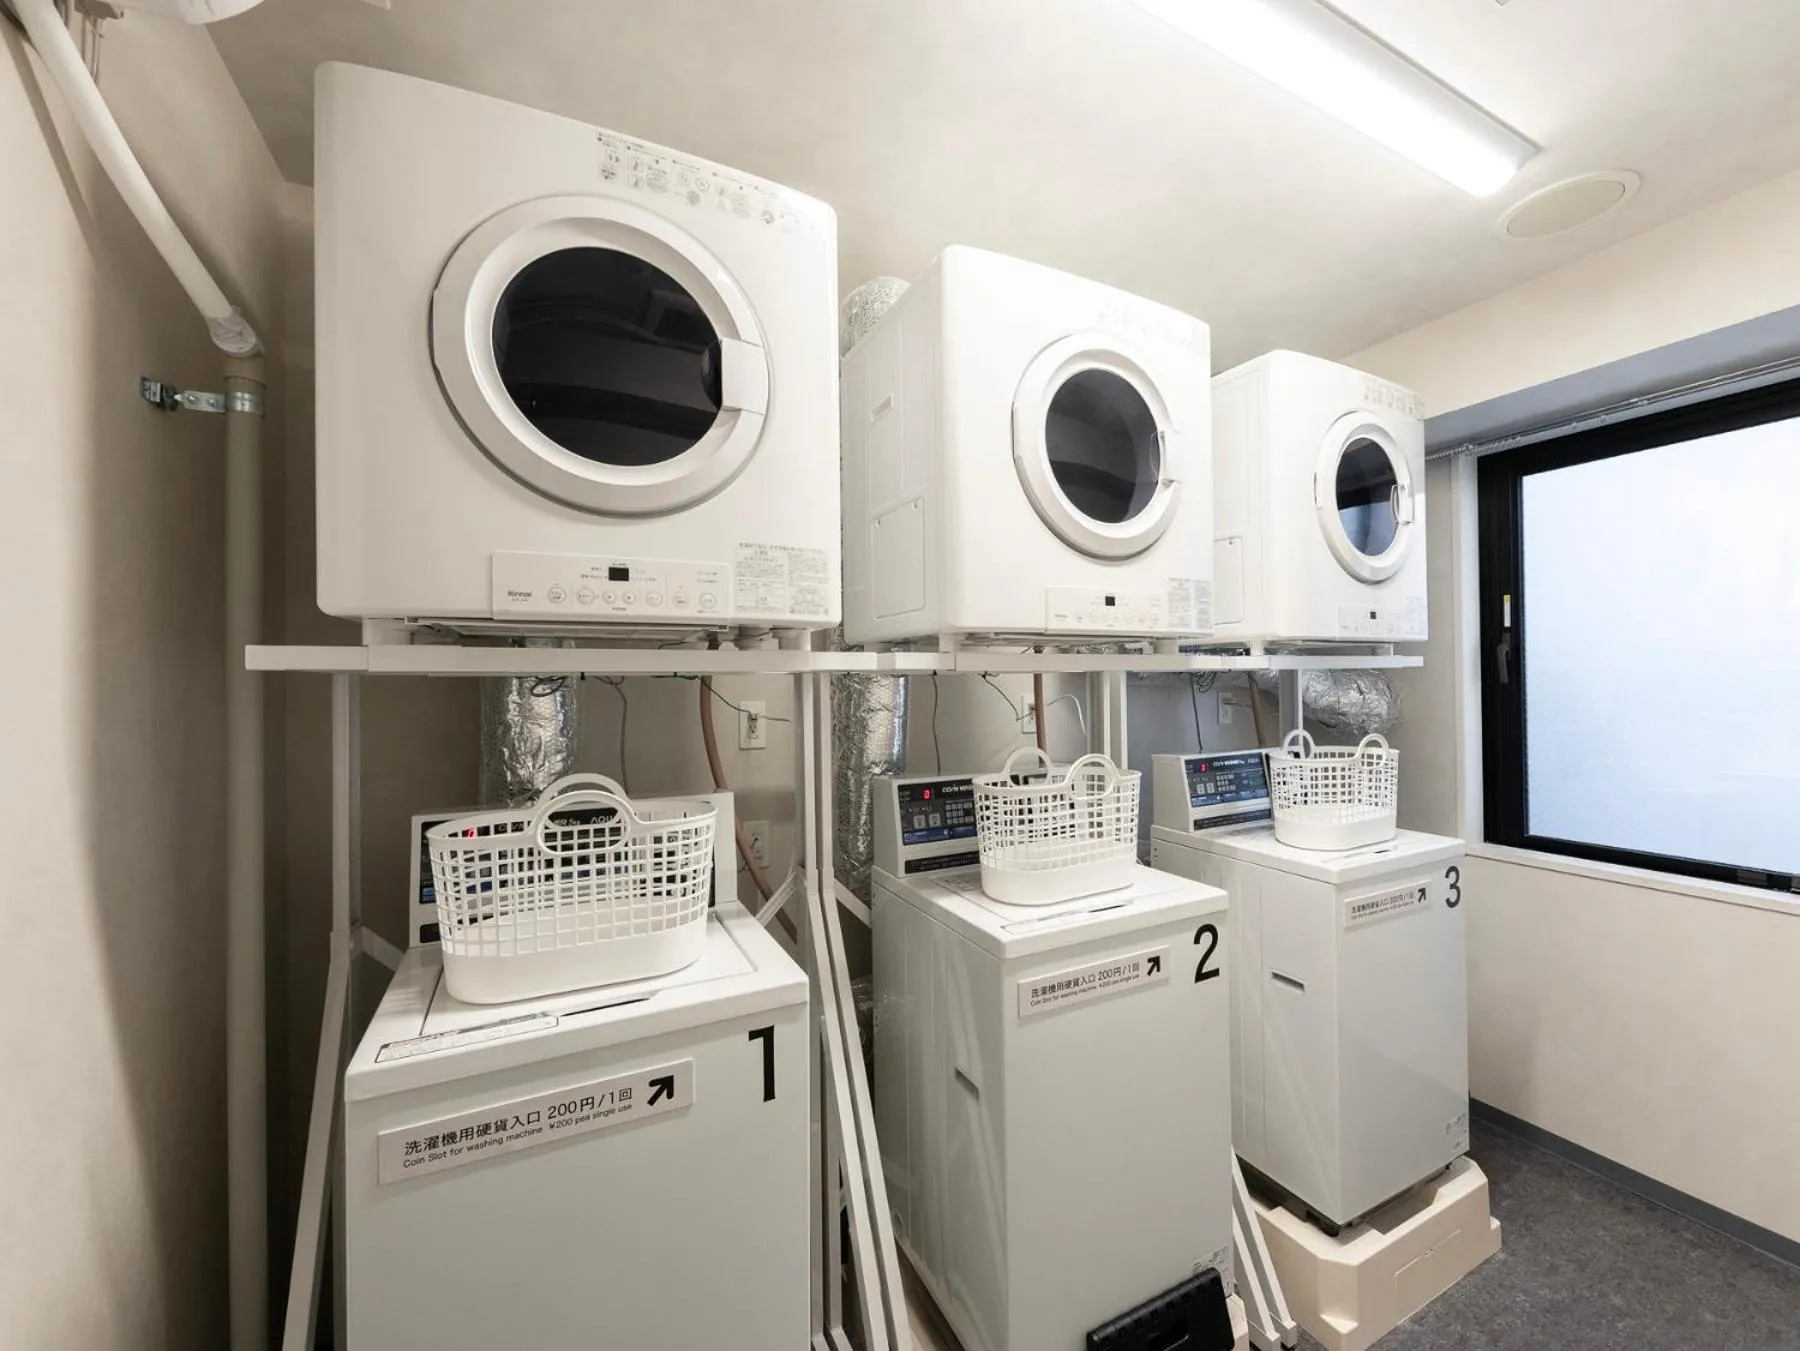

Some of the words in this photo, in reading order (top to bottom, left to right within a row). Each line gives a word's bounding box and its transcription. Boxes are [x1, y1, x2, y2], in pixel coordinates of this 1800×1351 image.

[1444, 865, 1461, 908] 3
[1193, 923, 1220, 984] 2
[749, 1025, 775, 1103] 1
[402, 1156, 426, 1169] Coin
[428, 1150, 447, 1162] Slot
[449, 1146, 464, 1157] for
[466, 1137, 504, 1153] washing
[506, 1126, 544, 1142] machine
[592, 1106, 617, 1119] single
[617, 1103, 633, 1113] use
[404, 1110, 541, 1156] 洗濯機用硬貨入口
[547, 1087, 633, 1120] 200円/1回
